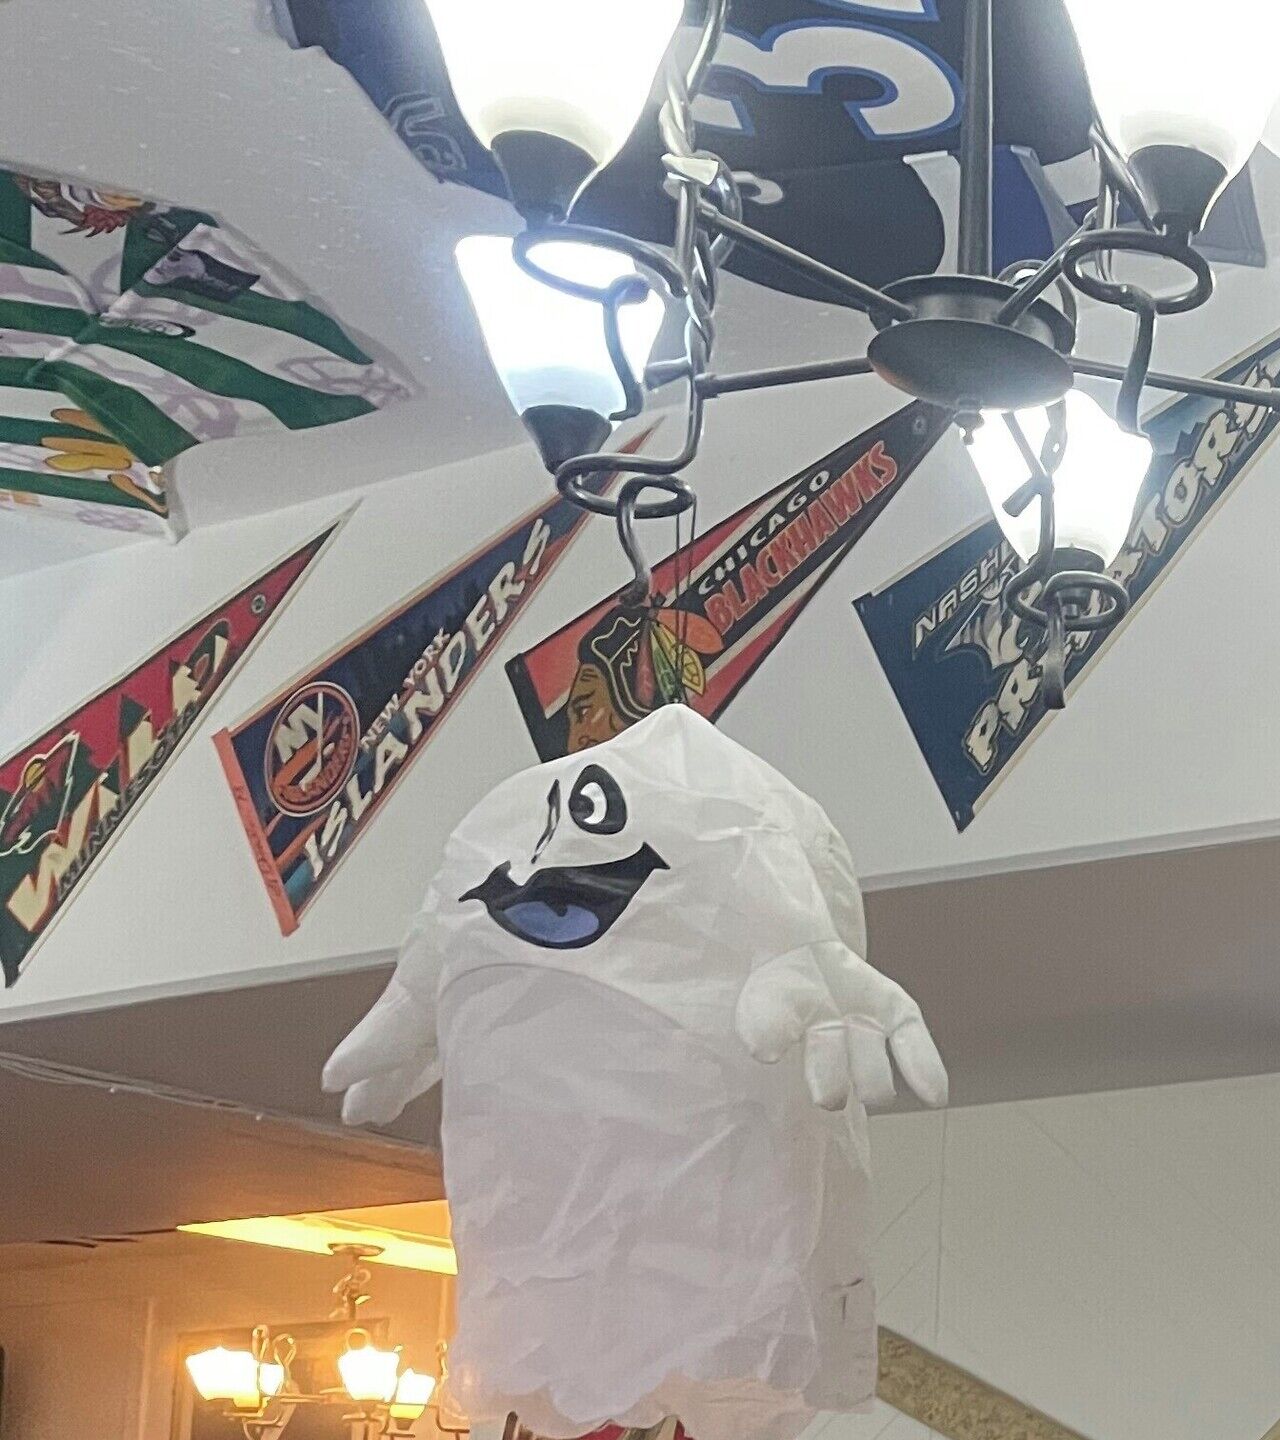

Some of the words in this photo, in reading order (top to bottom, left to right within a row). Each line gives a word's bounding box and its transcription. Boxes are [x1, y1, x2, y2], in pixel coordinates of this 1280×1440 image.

[699, 469, 830, 596] CHICAGO
[703, 440, 899, 636] BLACKHAWKS
[306, 517, 551, 879] ISLANDERS
[361, 692, 402, 751] NEW
[403, 625, 450, 692] YORK
